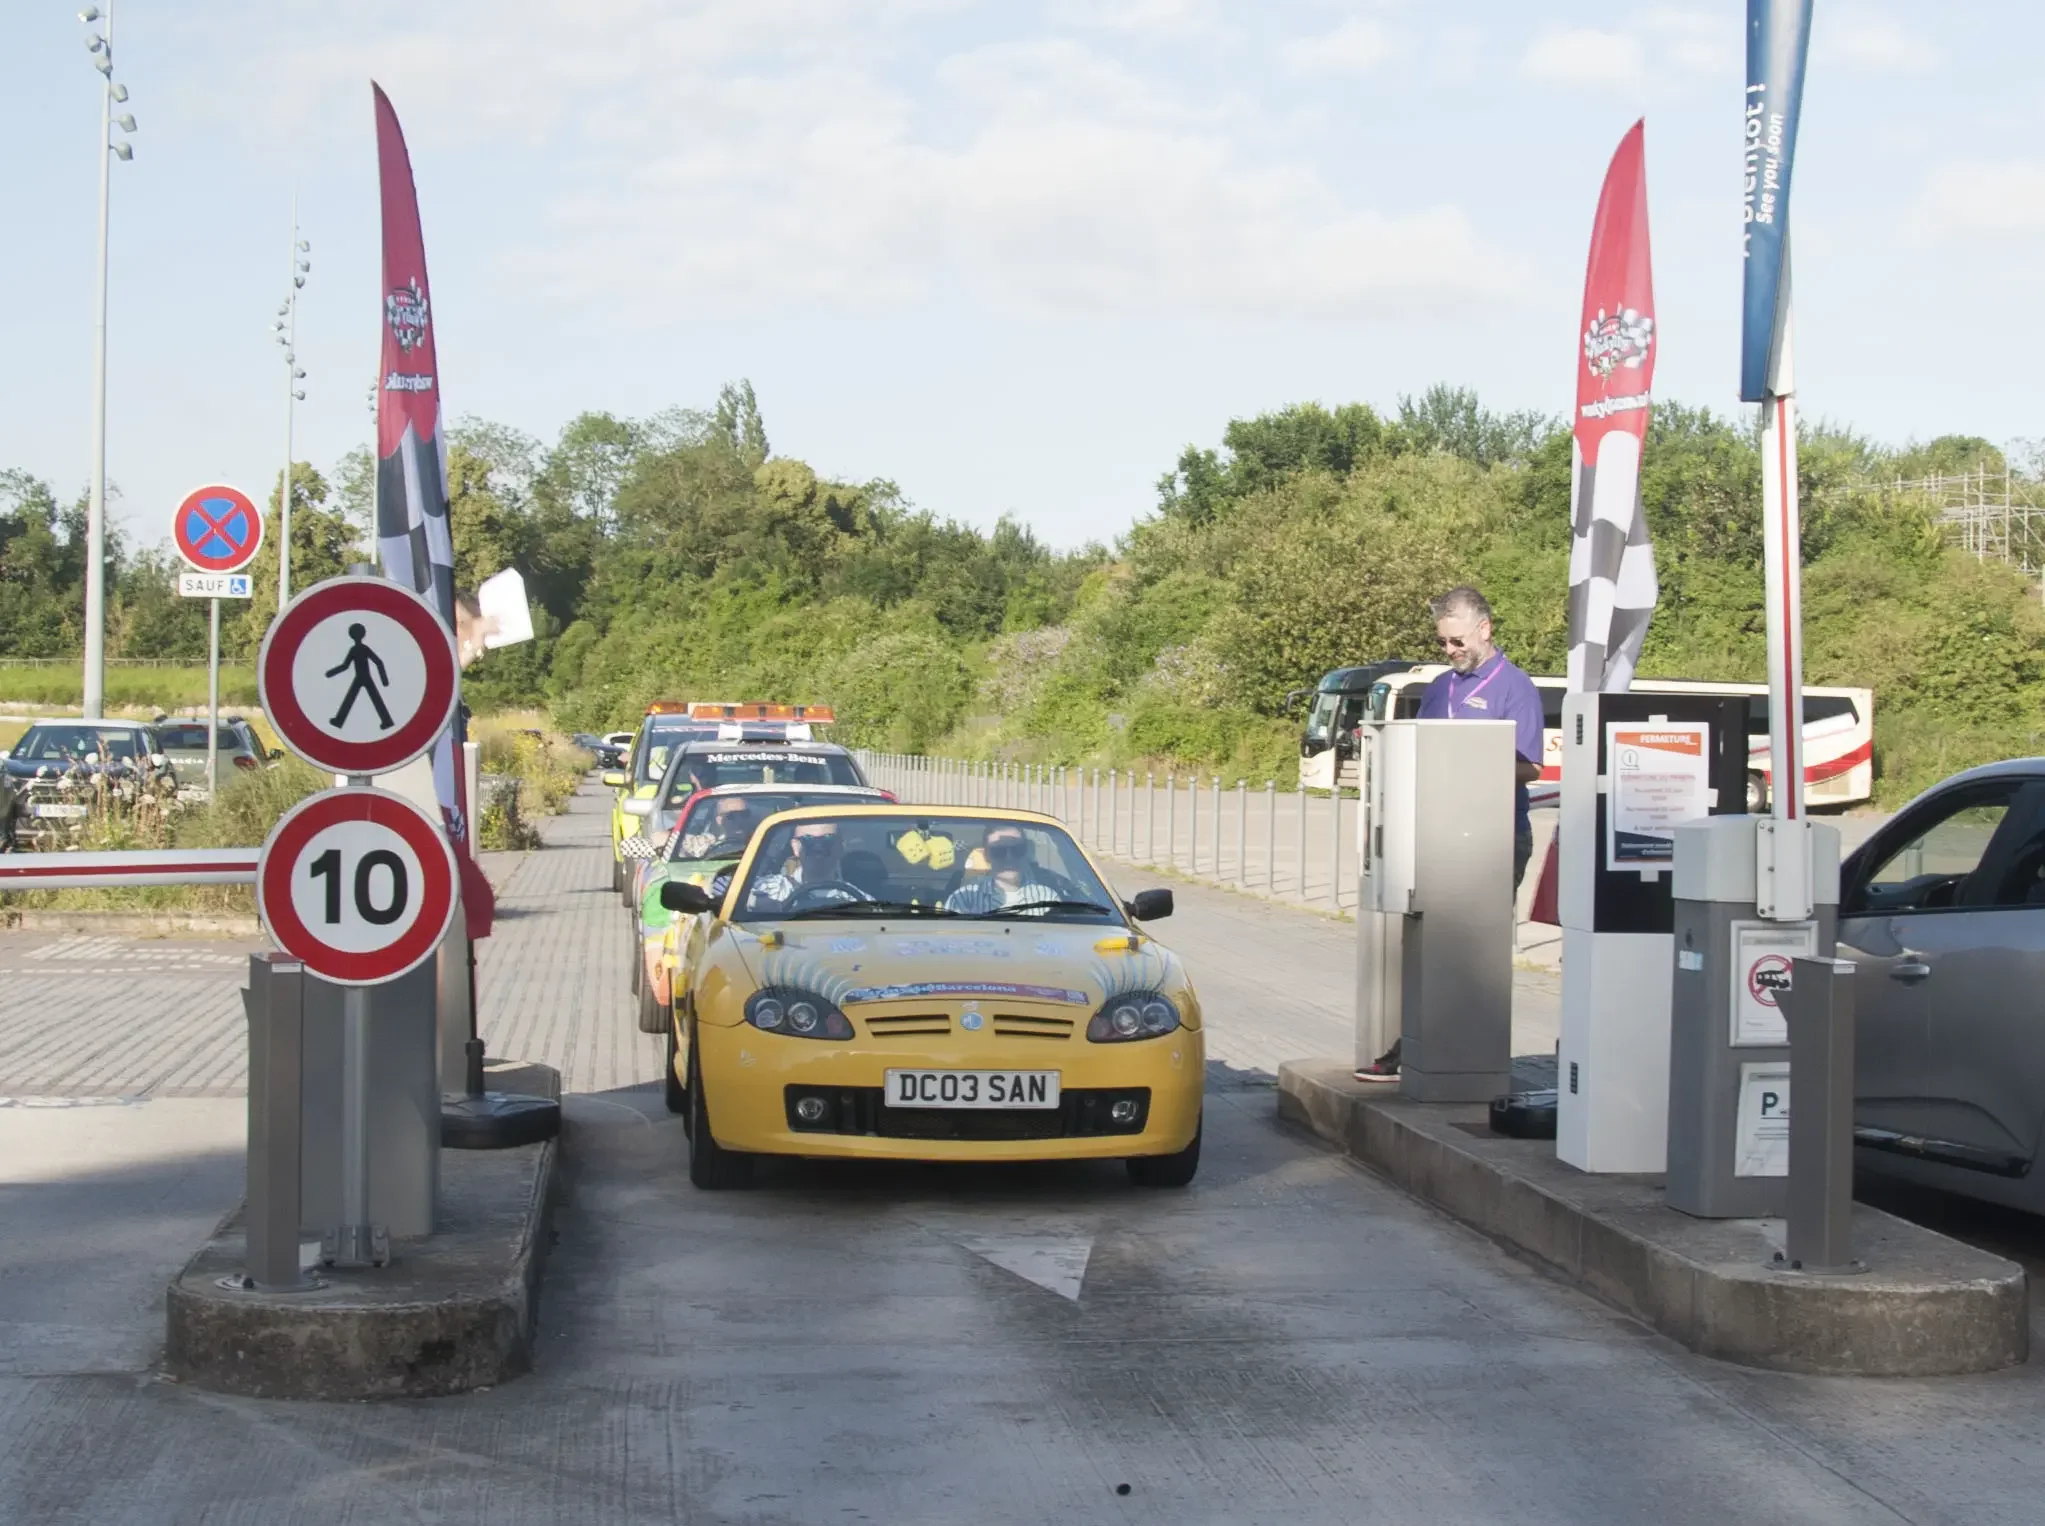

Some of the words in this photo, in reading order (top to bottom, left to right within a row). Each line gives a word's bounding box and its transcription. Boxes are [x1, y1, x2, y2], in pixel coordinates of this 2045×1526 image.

[1766, 113, 1785, 155] soon
[1762, 158, 1780, 190] you
[1755, 193, 1776, 224] See
[185, 579, 224, 592] SAUF
[707, 753, 826, 764] Mercedes-Benz
[310, 849, 408, 925] 10
[899, 1074, 978, 1102] DC03
[989, 1075, 1047, 1103] SAN
[1761, 1092, 1780, 1116] P
